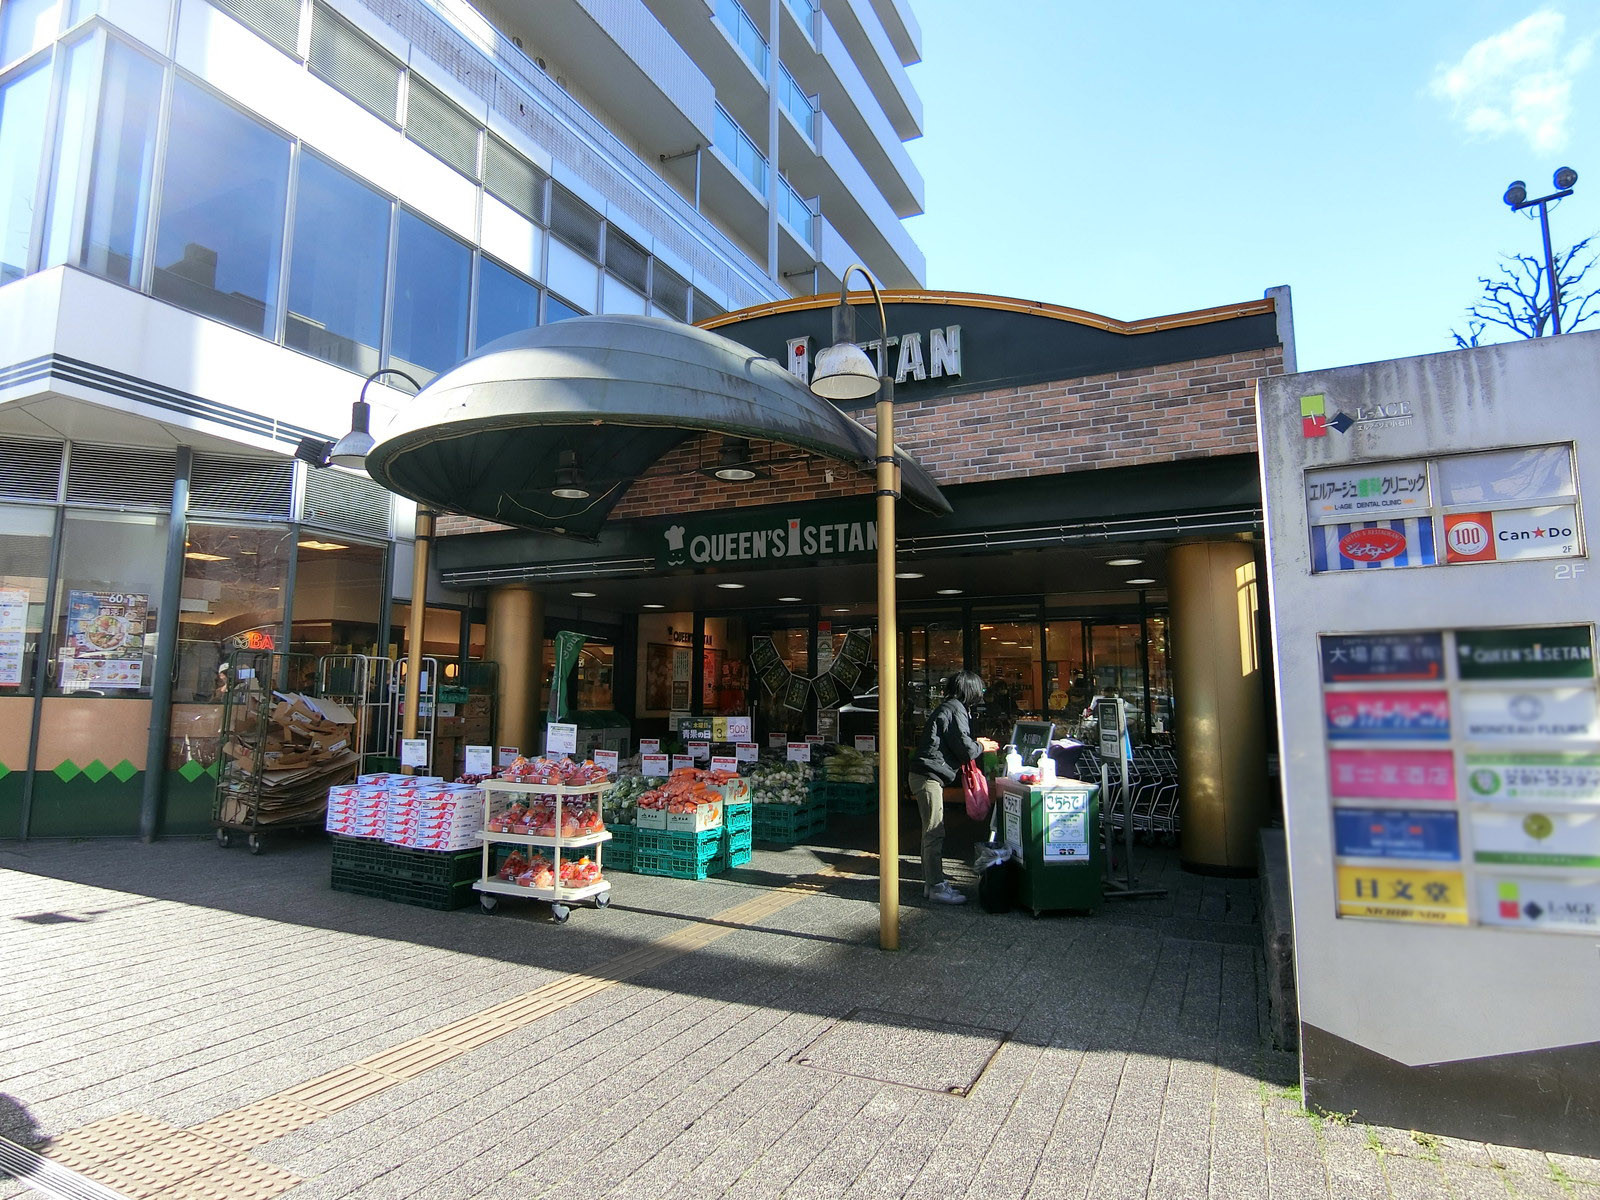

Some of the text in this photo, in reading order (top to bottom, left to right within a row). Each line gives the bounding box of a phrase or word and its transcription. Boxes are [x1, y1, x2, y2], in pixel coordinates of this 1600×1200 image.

[1356, 501, 1381, 509] DENTAL
[1381, 498, 1402, 506] CLINIC
[1454, 527, 1481, 546] 100
[1498, 527, 1572, 541] Can Do
[689, 528, 786, 564] QUEEN'S
[1562, 545, 1572, 554] 2F
[1554, 562, 1585, 580] 2F
[716, 727, 723, 739] 3
[729, 724, 746, 734] 500
